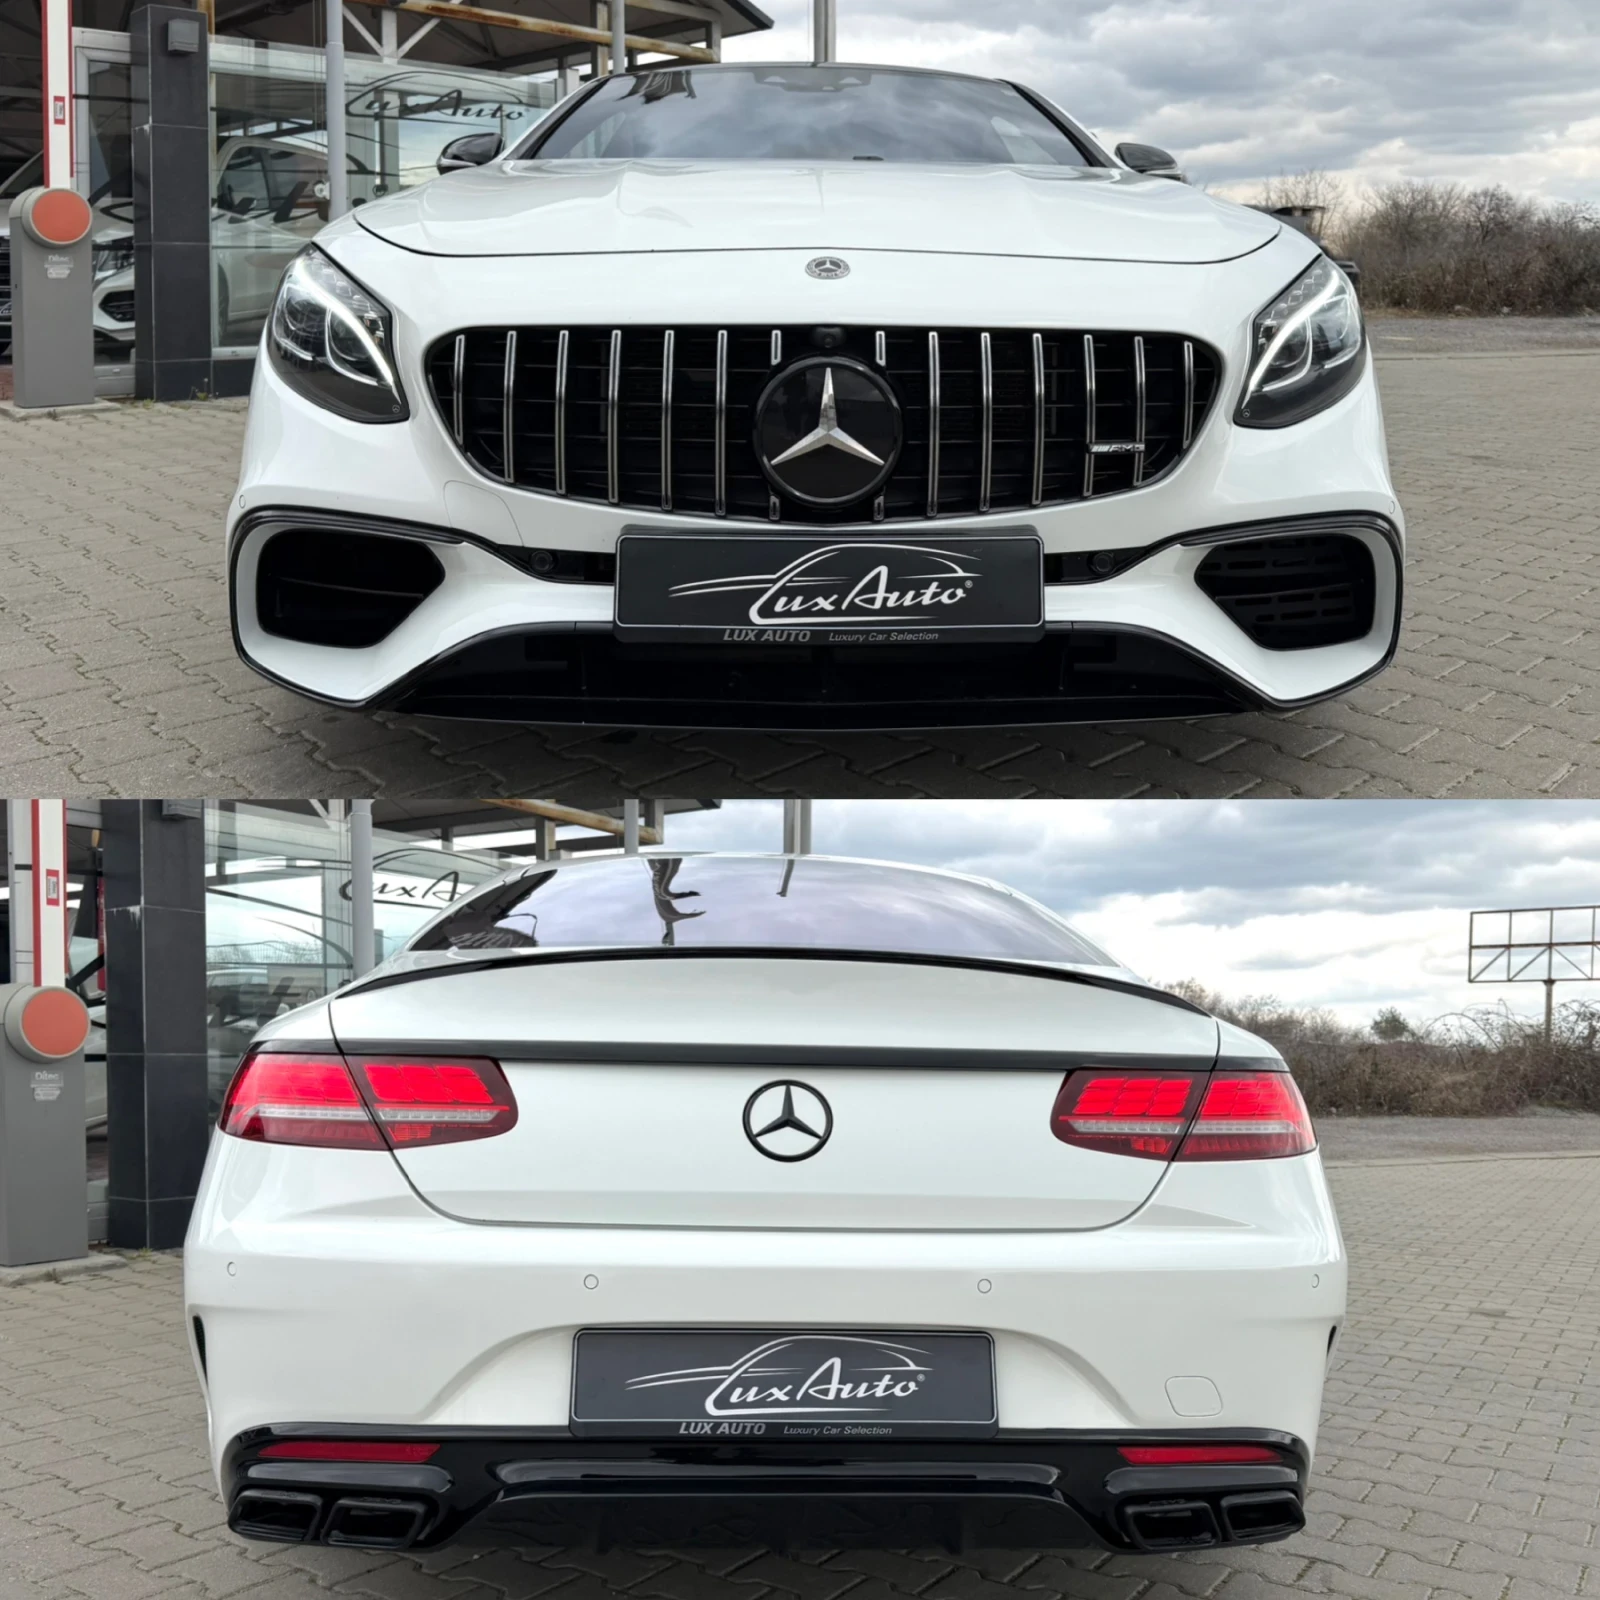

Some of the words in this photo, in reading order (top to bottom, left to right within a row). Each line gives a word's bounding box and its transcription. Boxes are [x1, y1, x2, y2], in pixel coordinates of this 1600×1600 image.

[723, 629, 758, 641] LUX
[760, 630, 811, 642] AUTO
[829, 632, 865, 642] Luxury
[868, 632, 886, 641] Car
[889, 631, 939, 641] Selection
[679, 1422, 715, 1434] LUX
[716, 1422, 766, 1435] AUTO
[784, 1425, 821, 1436] Luxury
[823, 1425, 841, 1435] Car
[844, 1425, 893, 1435] Selection
